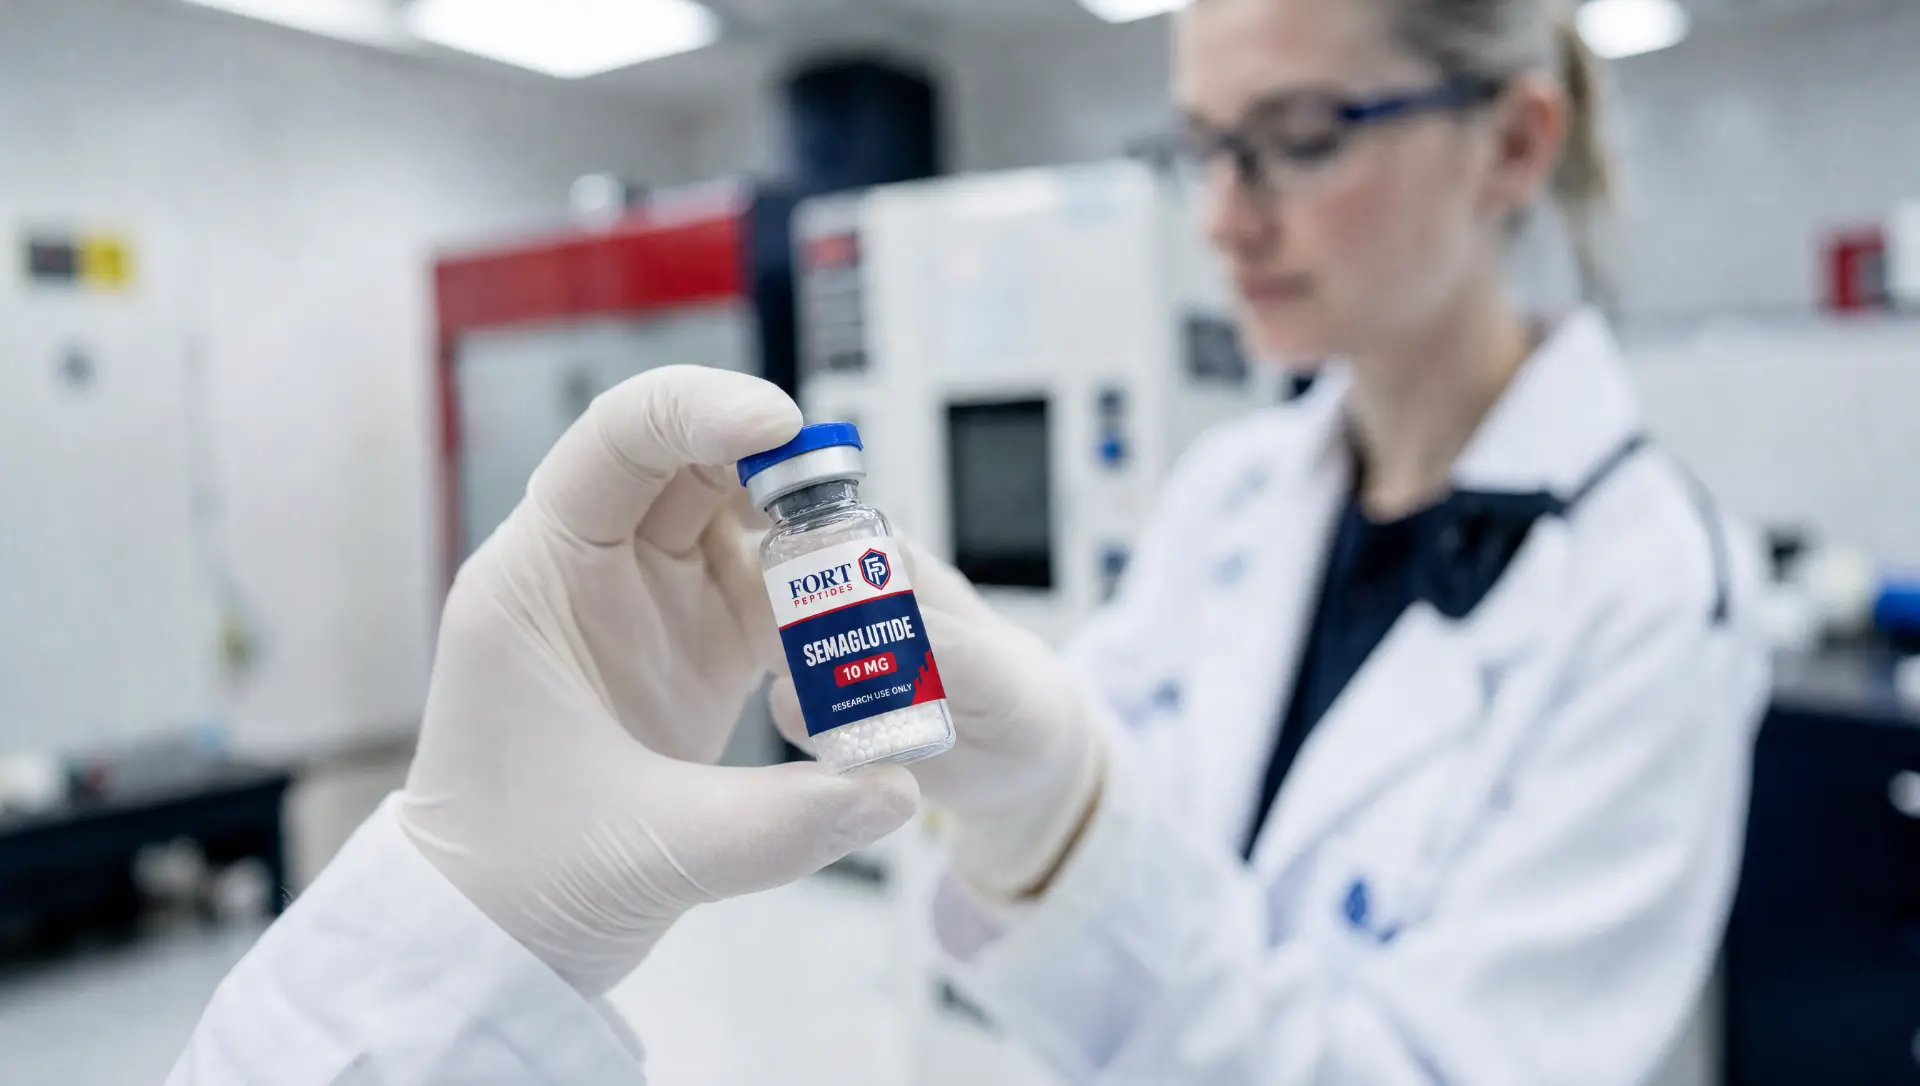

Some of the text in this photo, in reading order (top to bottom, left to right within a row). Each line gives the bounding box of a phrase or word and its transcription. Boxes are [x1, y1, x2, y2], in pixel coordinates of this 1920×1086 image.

[788, 563, 851, 599] FORT
[794, 583, 853, 608] PEPTIDES
[803, 616, 915, 667] SEMAGLUTIDE
[843, 657, 889, 681] 10 MG
[832, 683, 912, 712] RESEARCH USE ONLY
